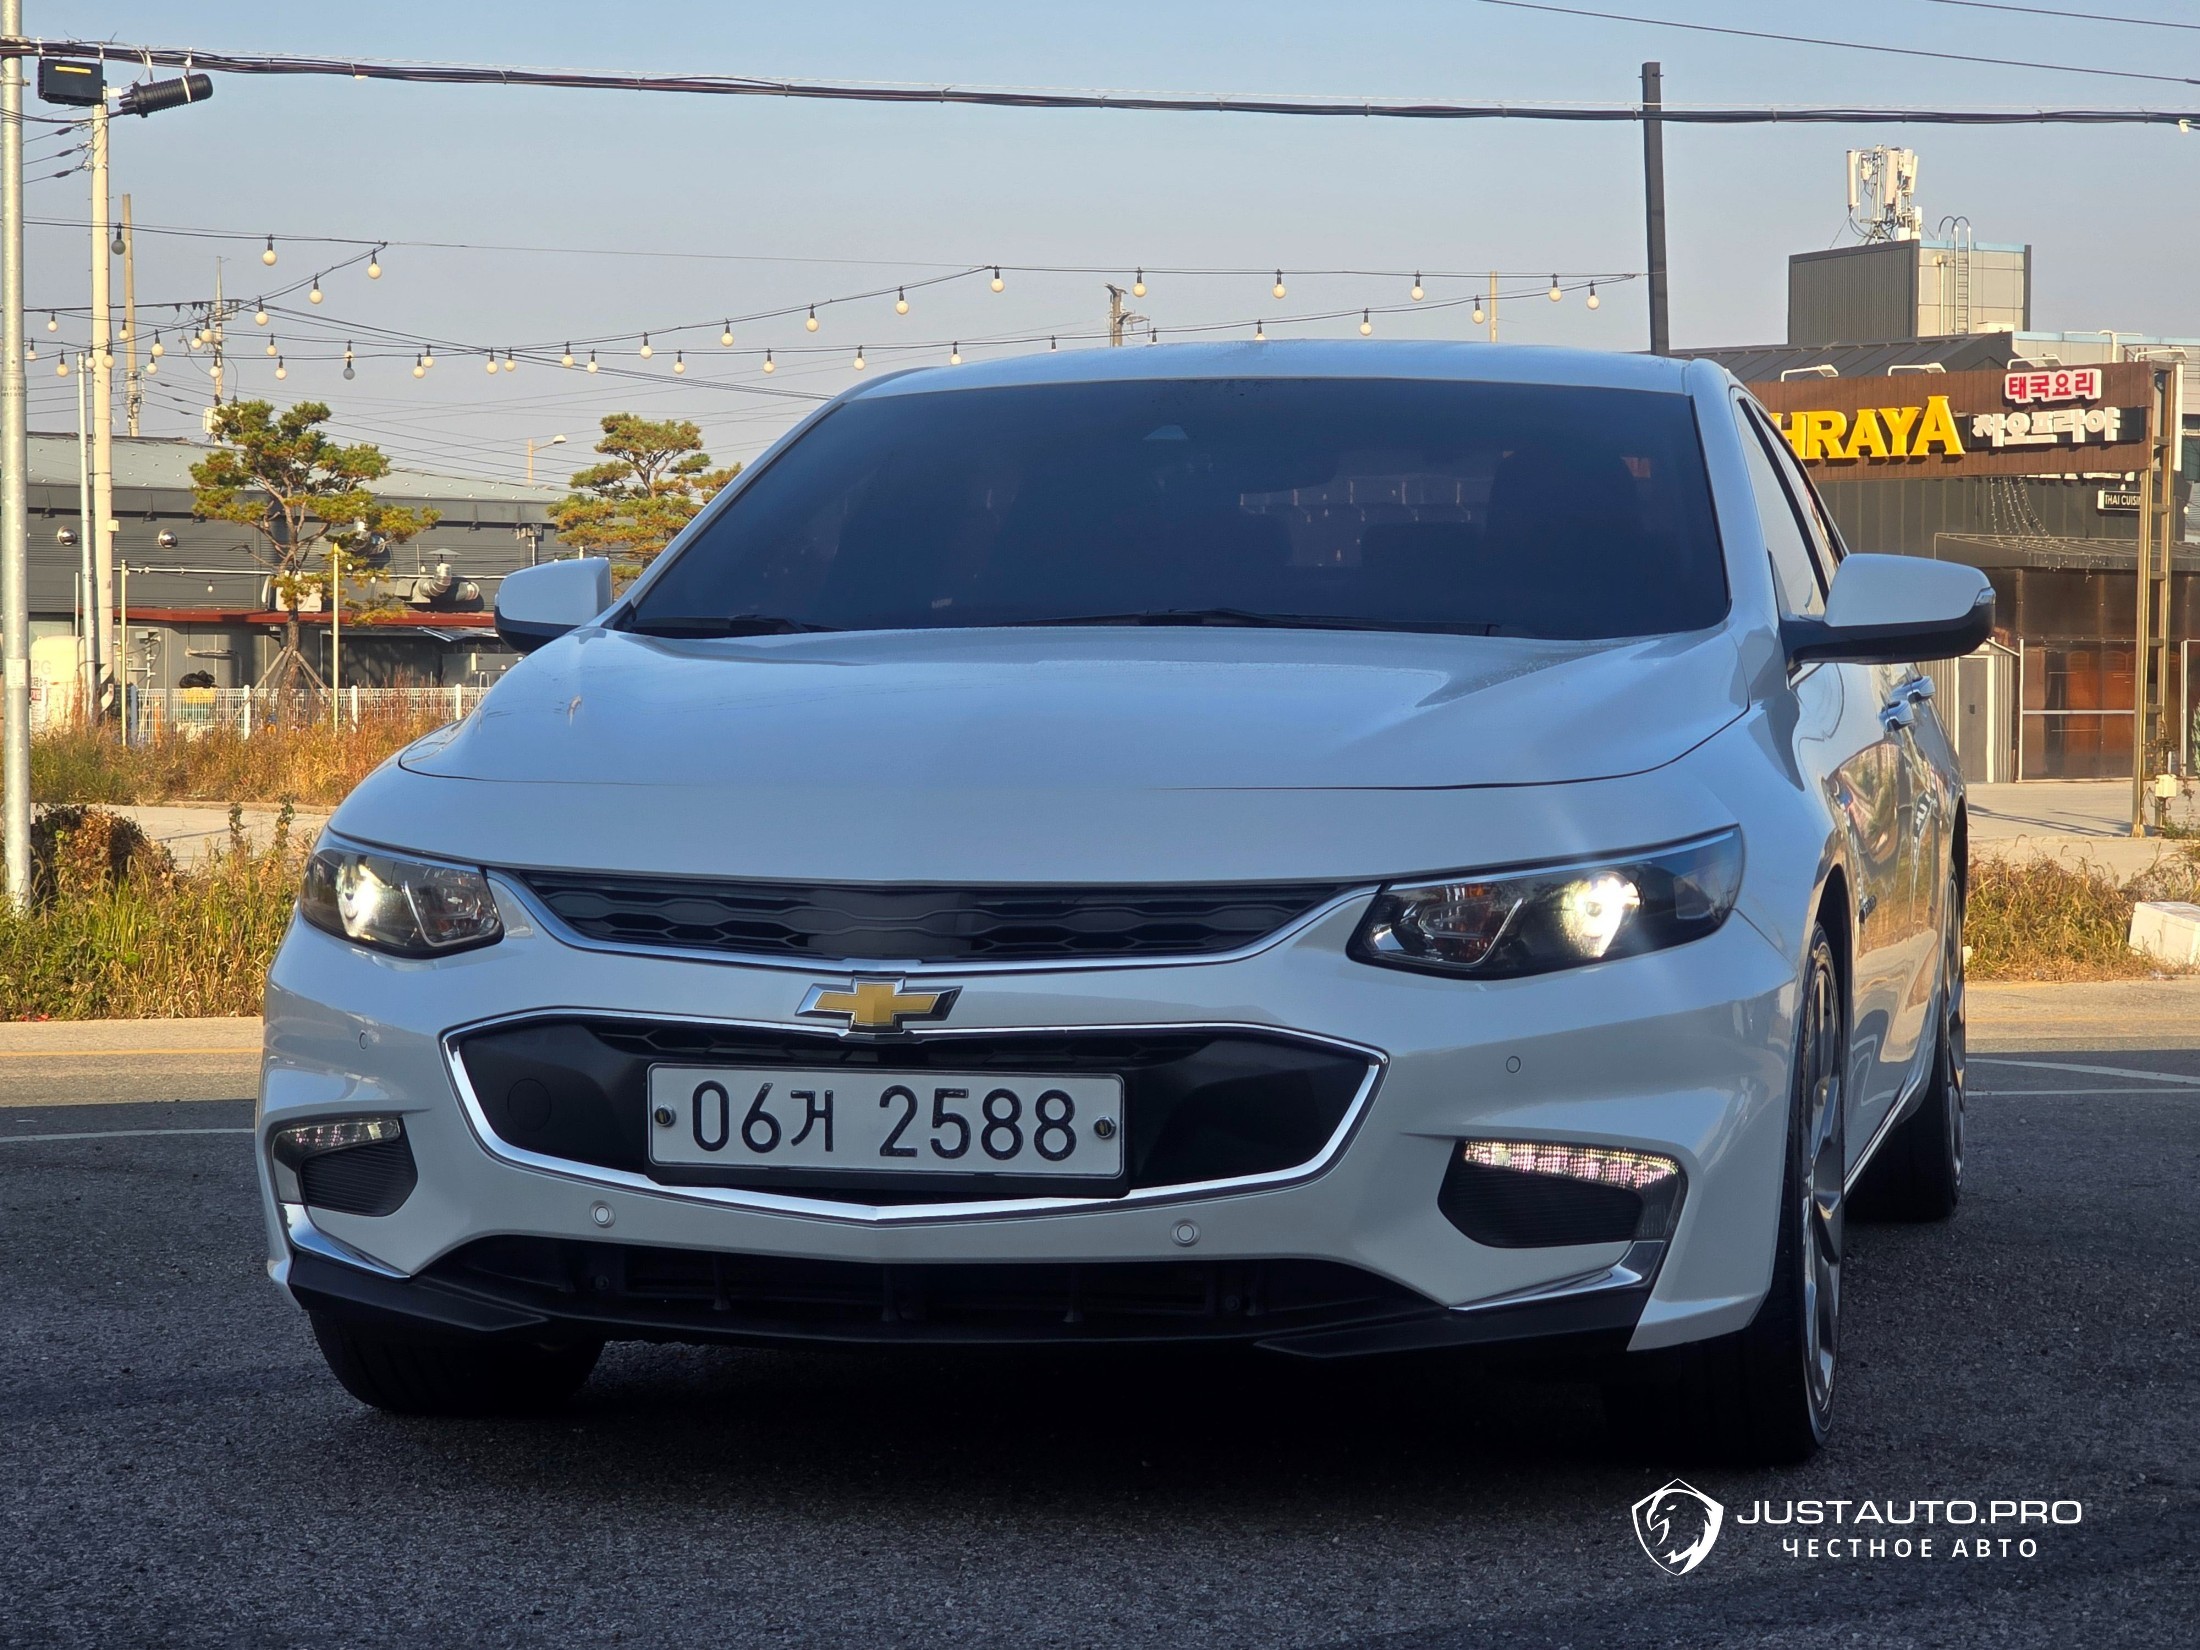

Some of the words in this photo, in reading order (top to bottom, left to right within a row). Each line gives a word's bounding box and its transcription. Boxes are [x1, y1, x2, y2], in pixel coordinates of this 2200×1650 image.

[2008, 373, 2094, 400] 태국요리
[1972, 406, 2121, 447] 차오프라야
[2105, 494, 2120, 505] THAI
[692, 1080, 834, 1153] 06거
[879, 1084, 1077, 1162] 2588
